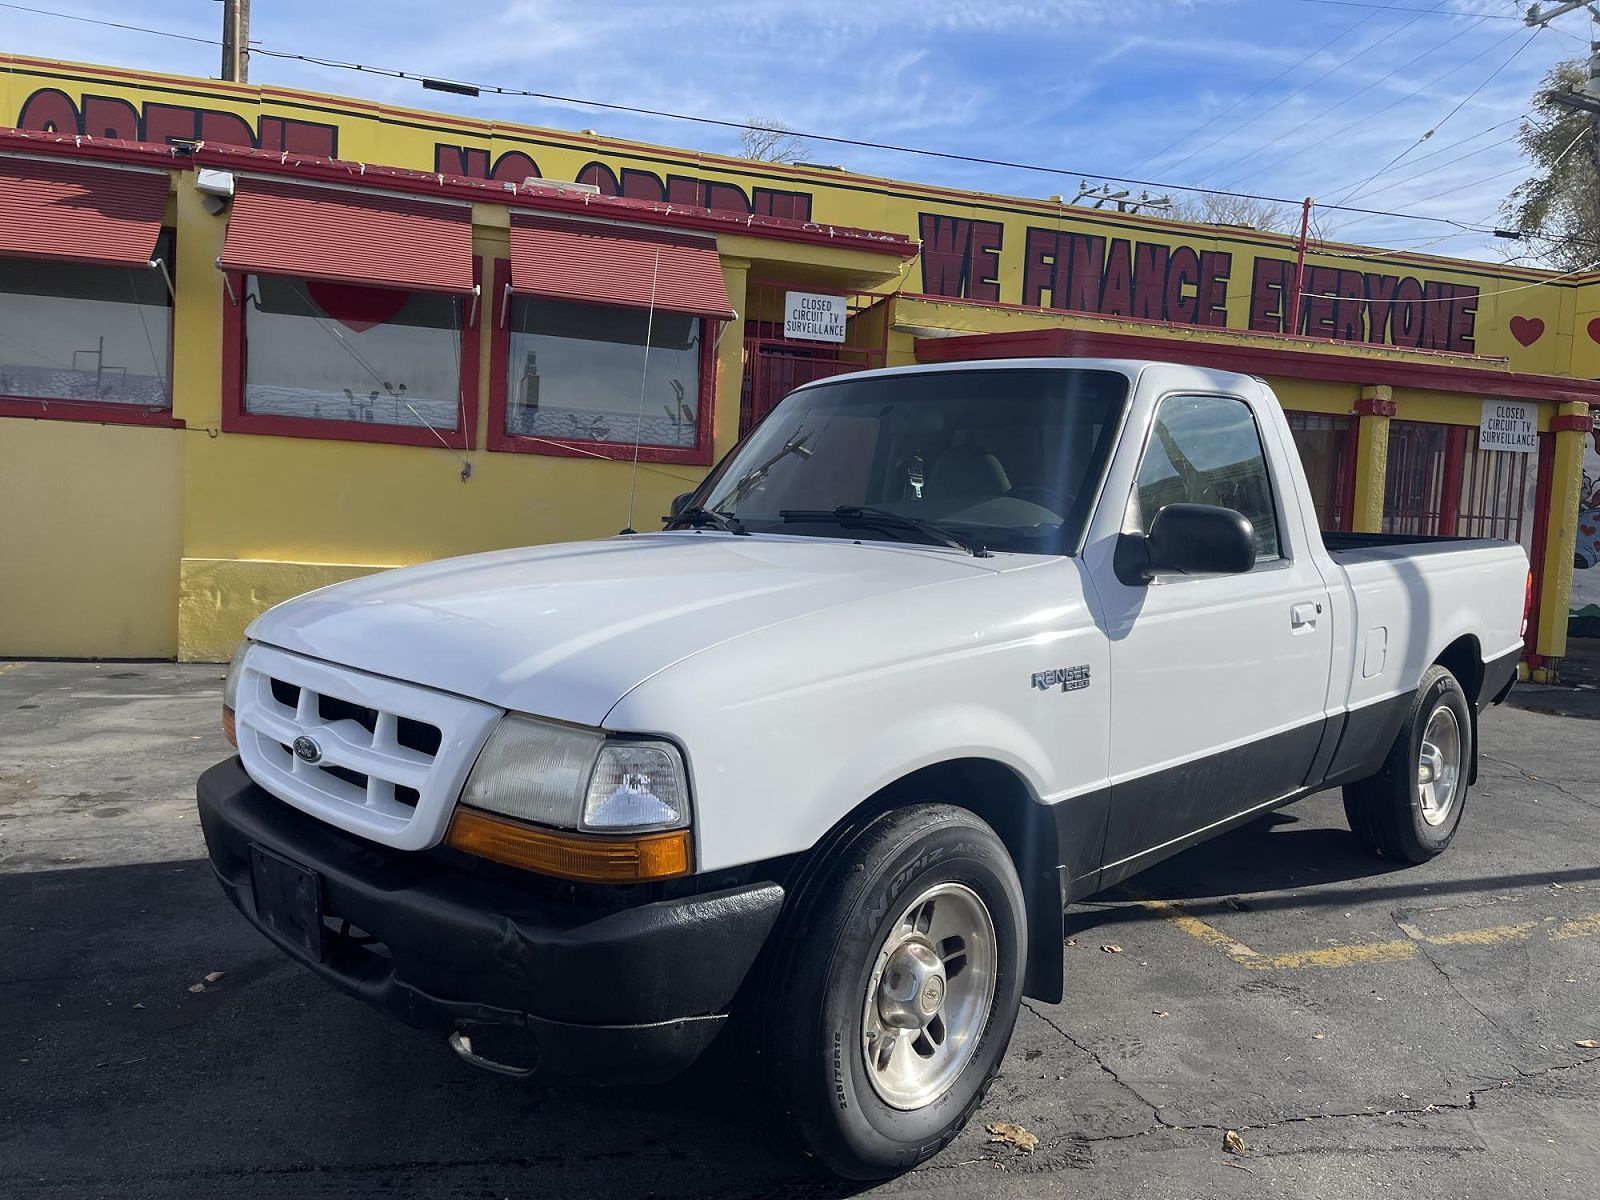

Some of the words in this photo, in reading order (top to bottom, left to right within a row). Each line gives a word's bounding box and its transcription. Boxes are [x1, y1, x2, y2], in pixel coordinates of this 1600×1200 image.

[918, 212, 1003, 302] WE
[1022, 226, 1232, 327] FINANCE
[1248, 256, 1480, 353] EVERYONE
[801, 298, 832, 311] CLOSED
[793, 309, 824, 322] CIRCUIT
[829, 313, 839, 324] TV
[786, 320, 844, 337] SURVEILLANCE
[1496, 406, 1525, 420] CLOSED
[1488, 418, 1517, 432] CIRCUIT
[1522, 421, 1531, 433] TV
[1481, 430, 1536, 446] SURVEILLANCE
